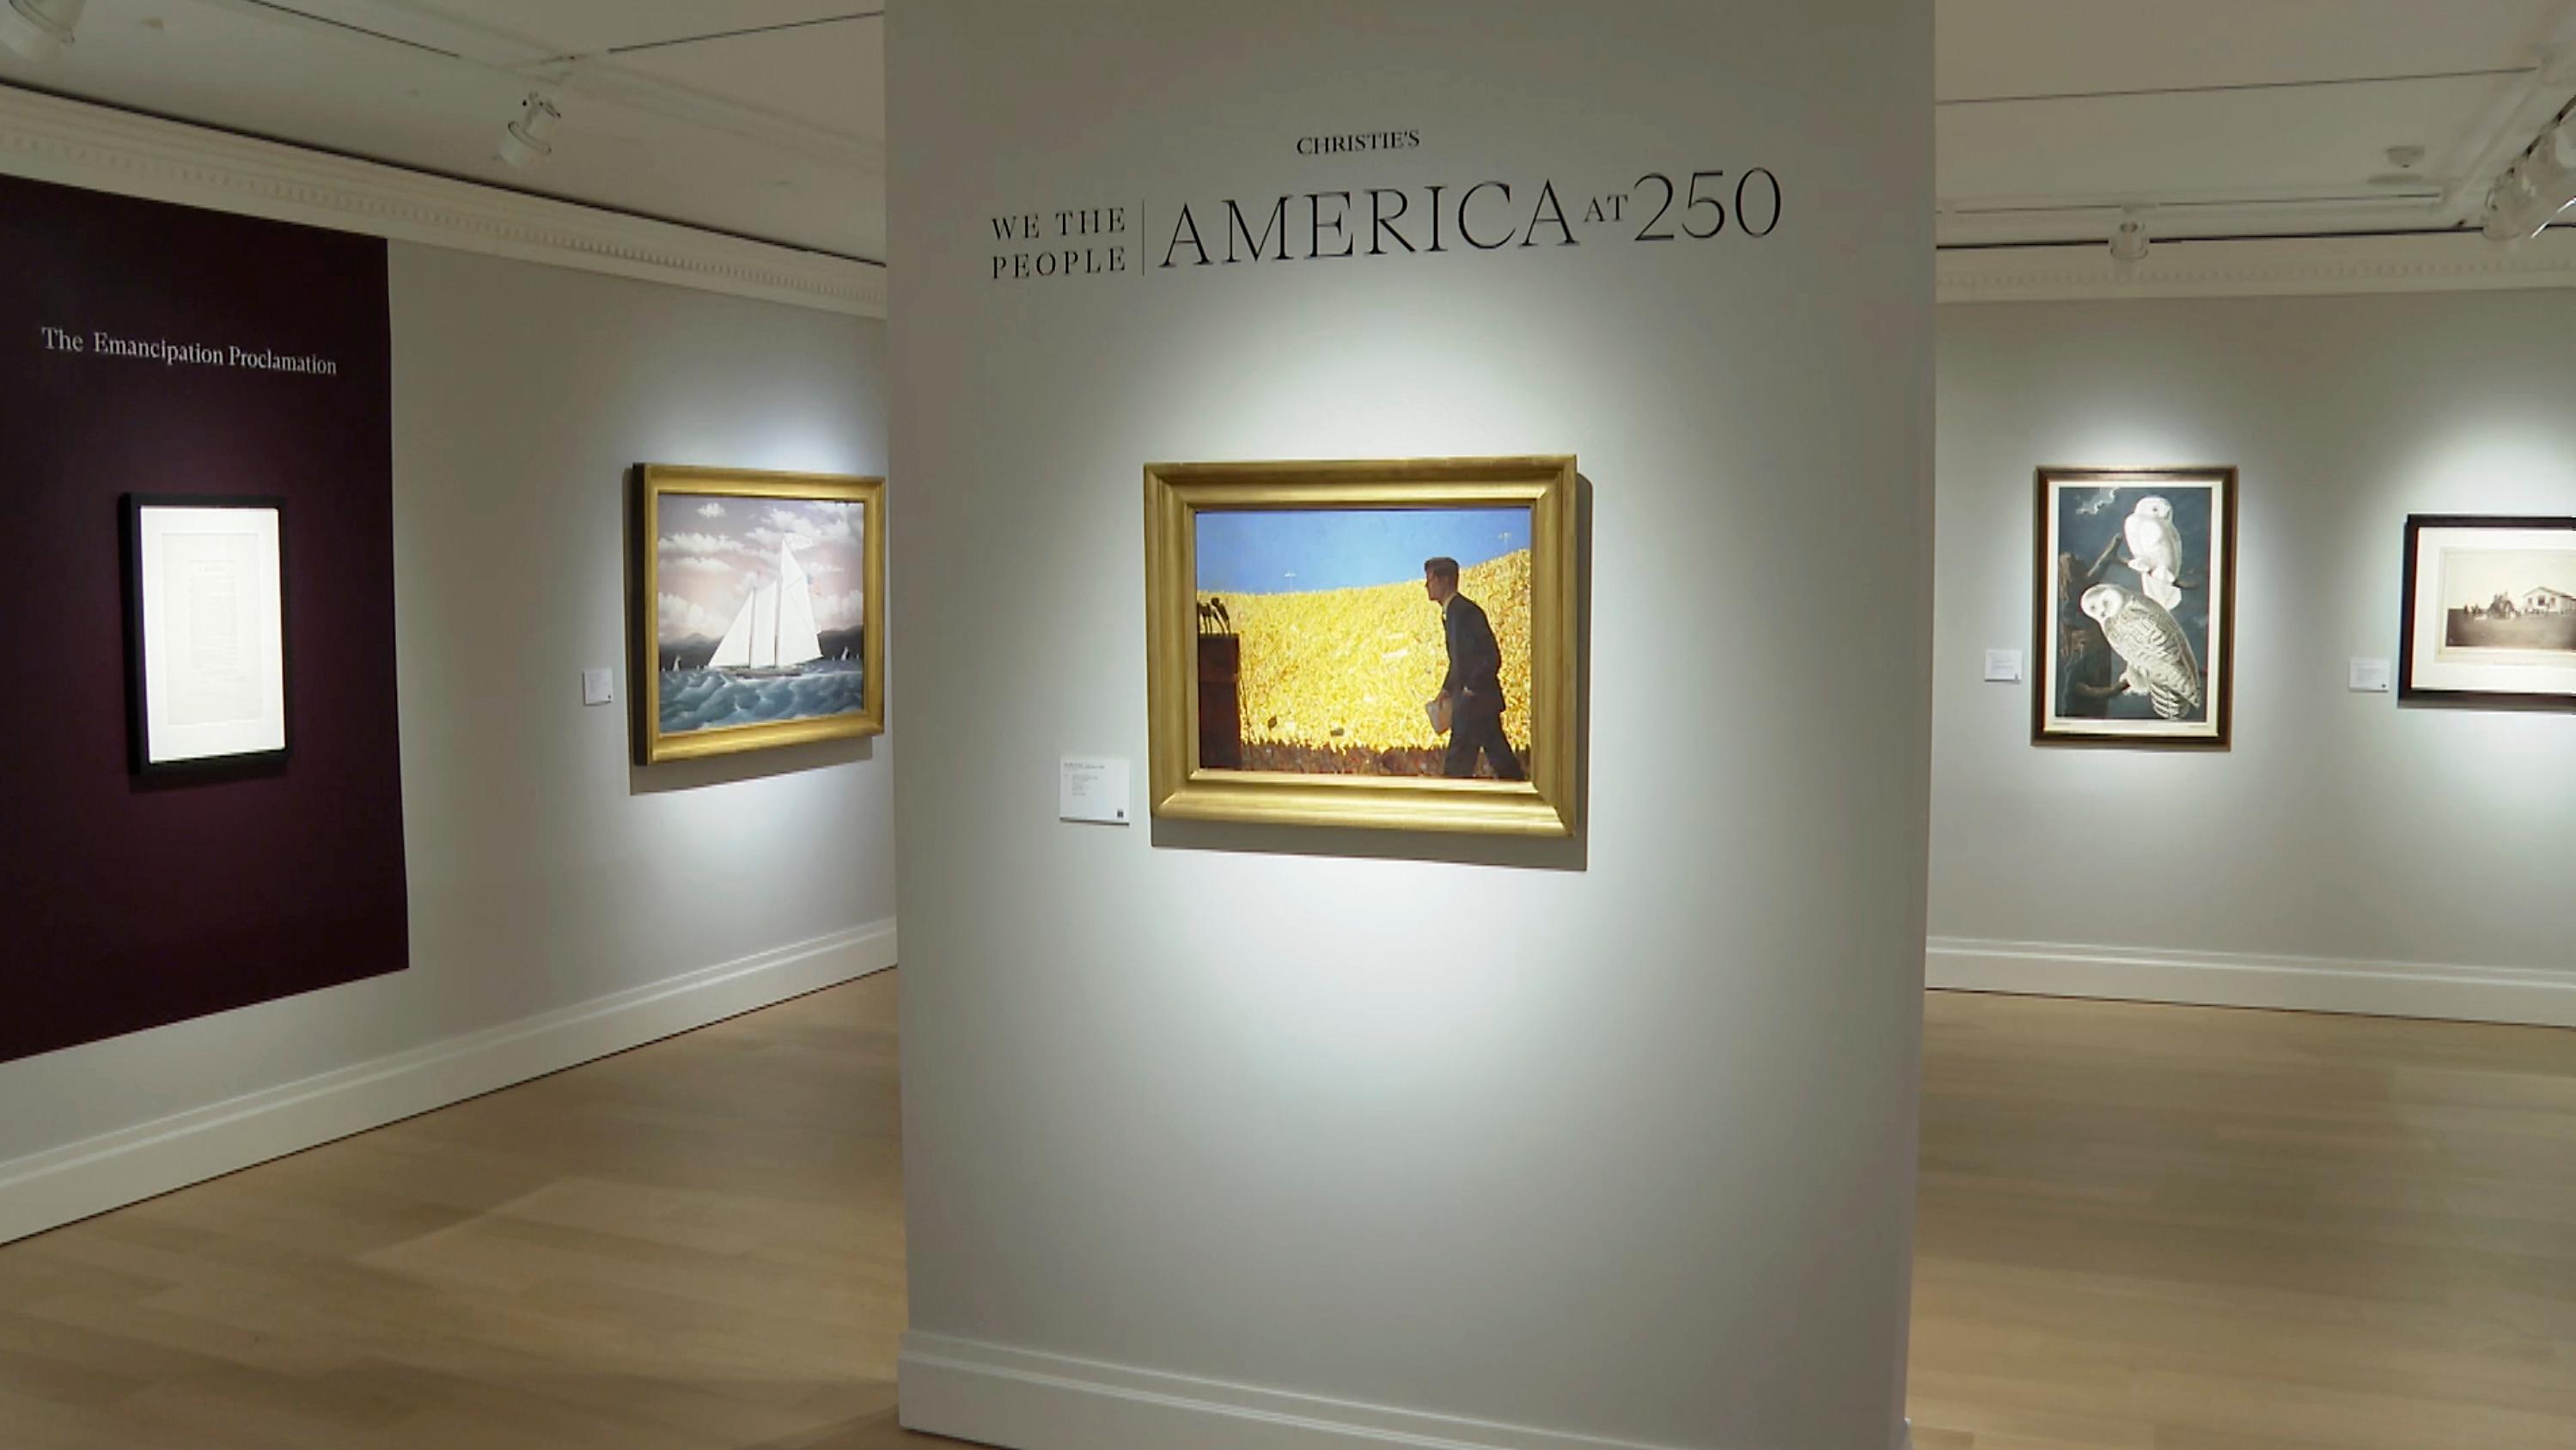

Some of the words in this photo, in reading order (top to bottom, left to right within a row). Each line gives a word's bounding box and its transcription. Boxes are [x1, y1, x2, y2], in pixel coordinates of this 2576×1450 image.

[1296, 130, 1420, 156] CHRISTIE'S
[991, 212, 1040, 241] WE
[1055, 205, 1126, 236] THE
[1157, 177, 1581, 269] AMERICA
[1584, 192, 1629, 223] AT
[1633, 167, 1781, 242] 250
[992, 245, 1126, 280] PEOPLE
[40, 326, 84, 353] The
[93, 331, 224, 367] Emancipation
[228, 344, 338, 376] Proclamation
